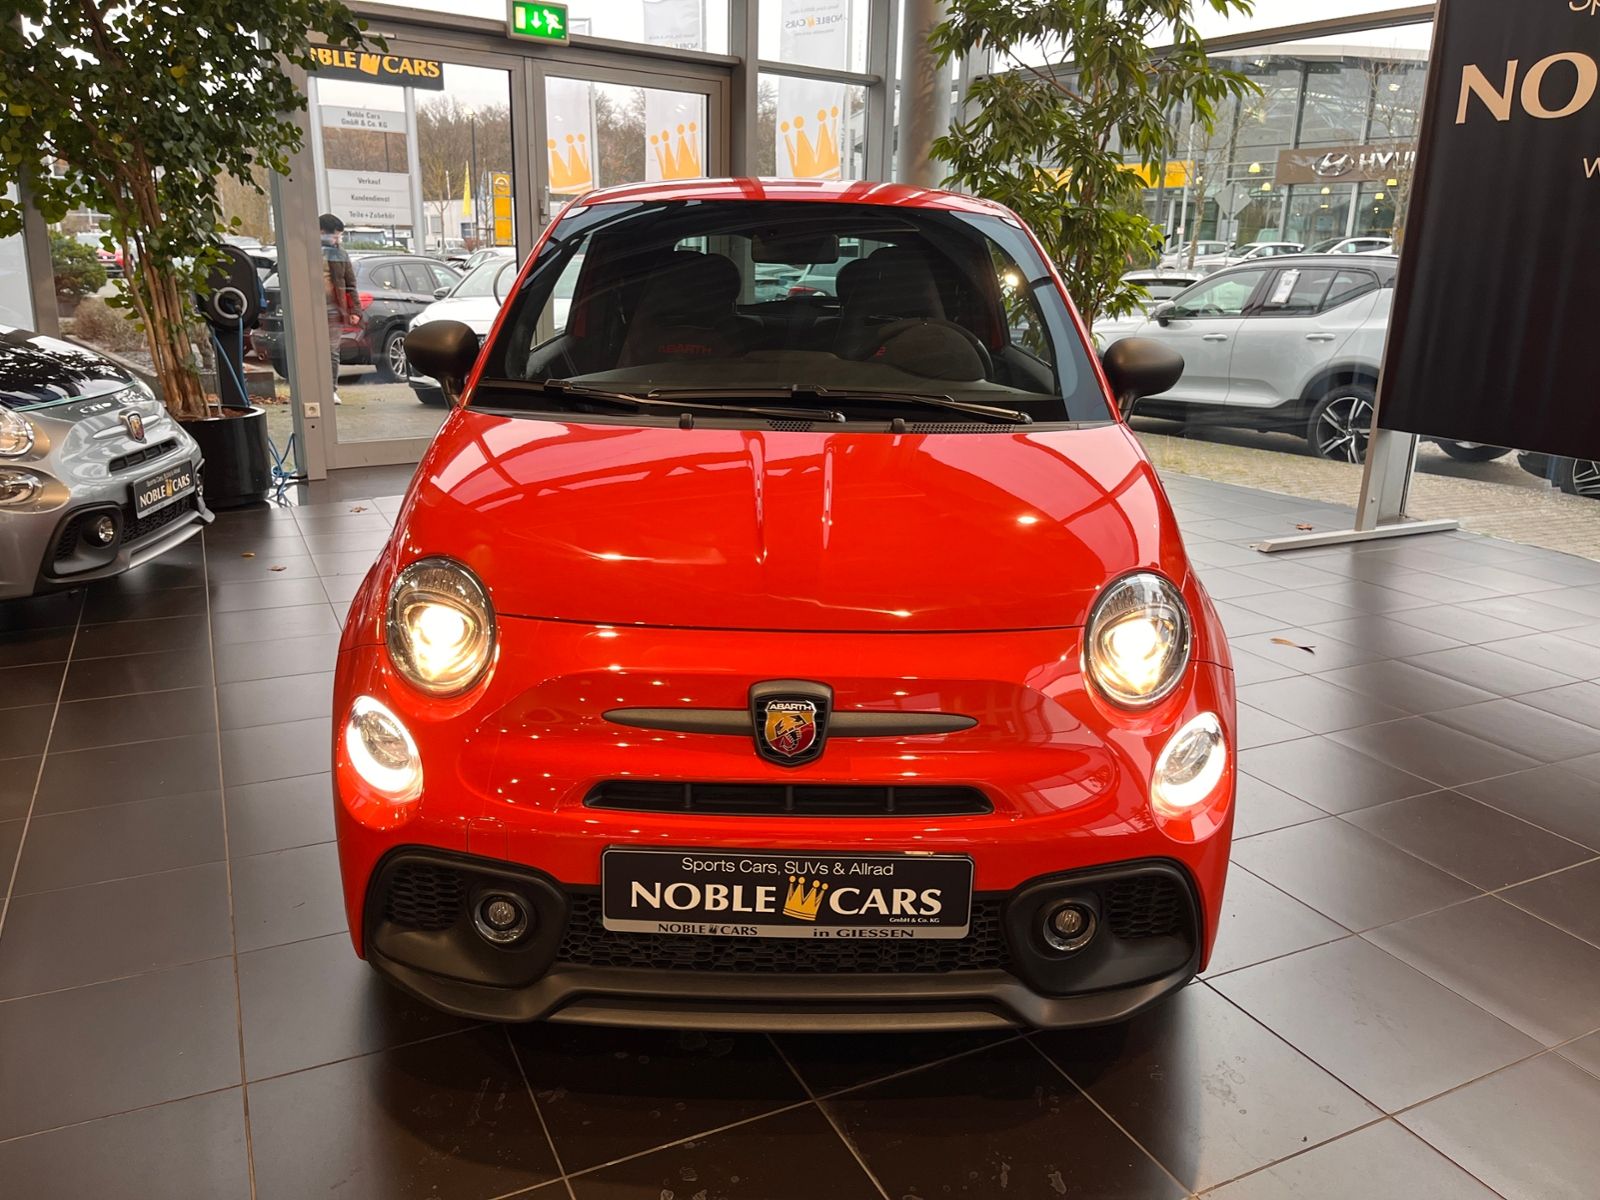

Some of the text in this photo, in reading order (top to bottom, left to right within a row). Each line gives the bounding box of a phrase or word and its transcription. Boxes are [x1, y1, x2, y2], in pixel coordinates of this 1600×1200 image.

[382, 56, 441, 78] CARS
[357, 177, 381, 185] Verkauf
[351, 194, 391, 202] Kundendienst
[139, 484, 167, 508] NOBLE
[172, 473, 191, 492] CARS
[769, 703, 812, 711] ABARTH
[682, 857, 894, 876] Sports Cars, SUVs & Allrad
[630, 880, 942, 916] NOBLE CARS
[658, 923, 914, 938] NOBLE CARS in GIESSEN
